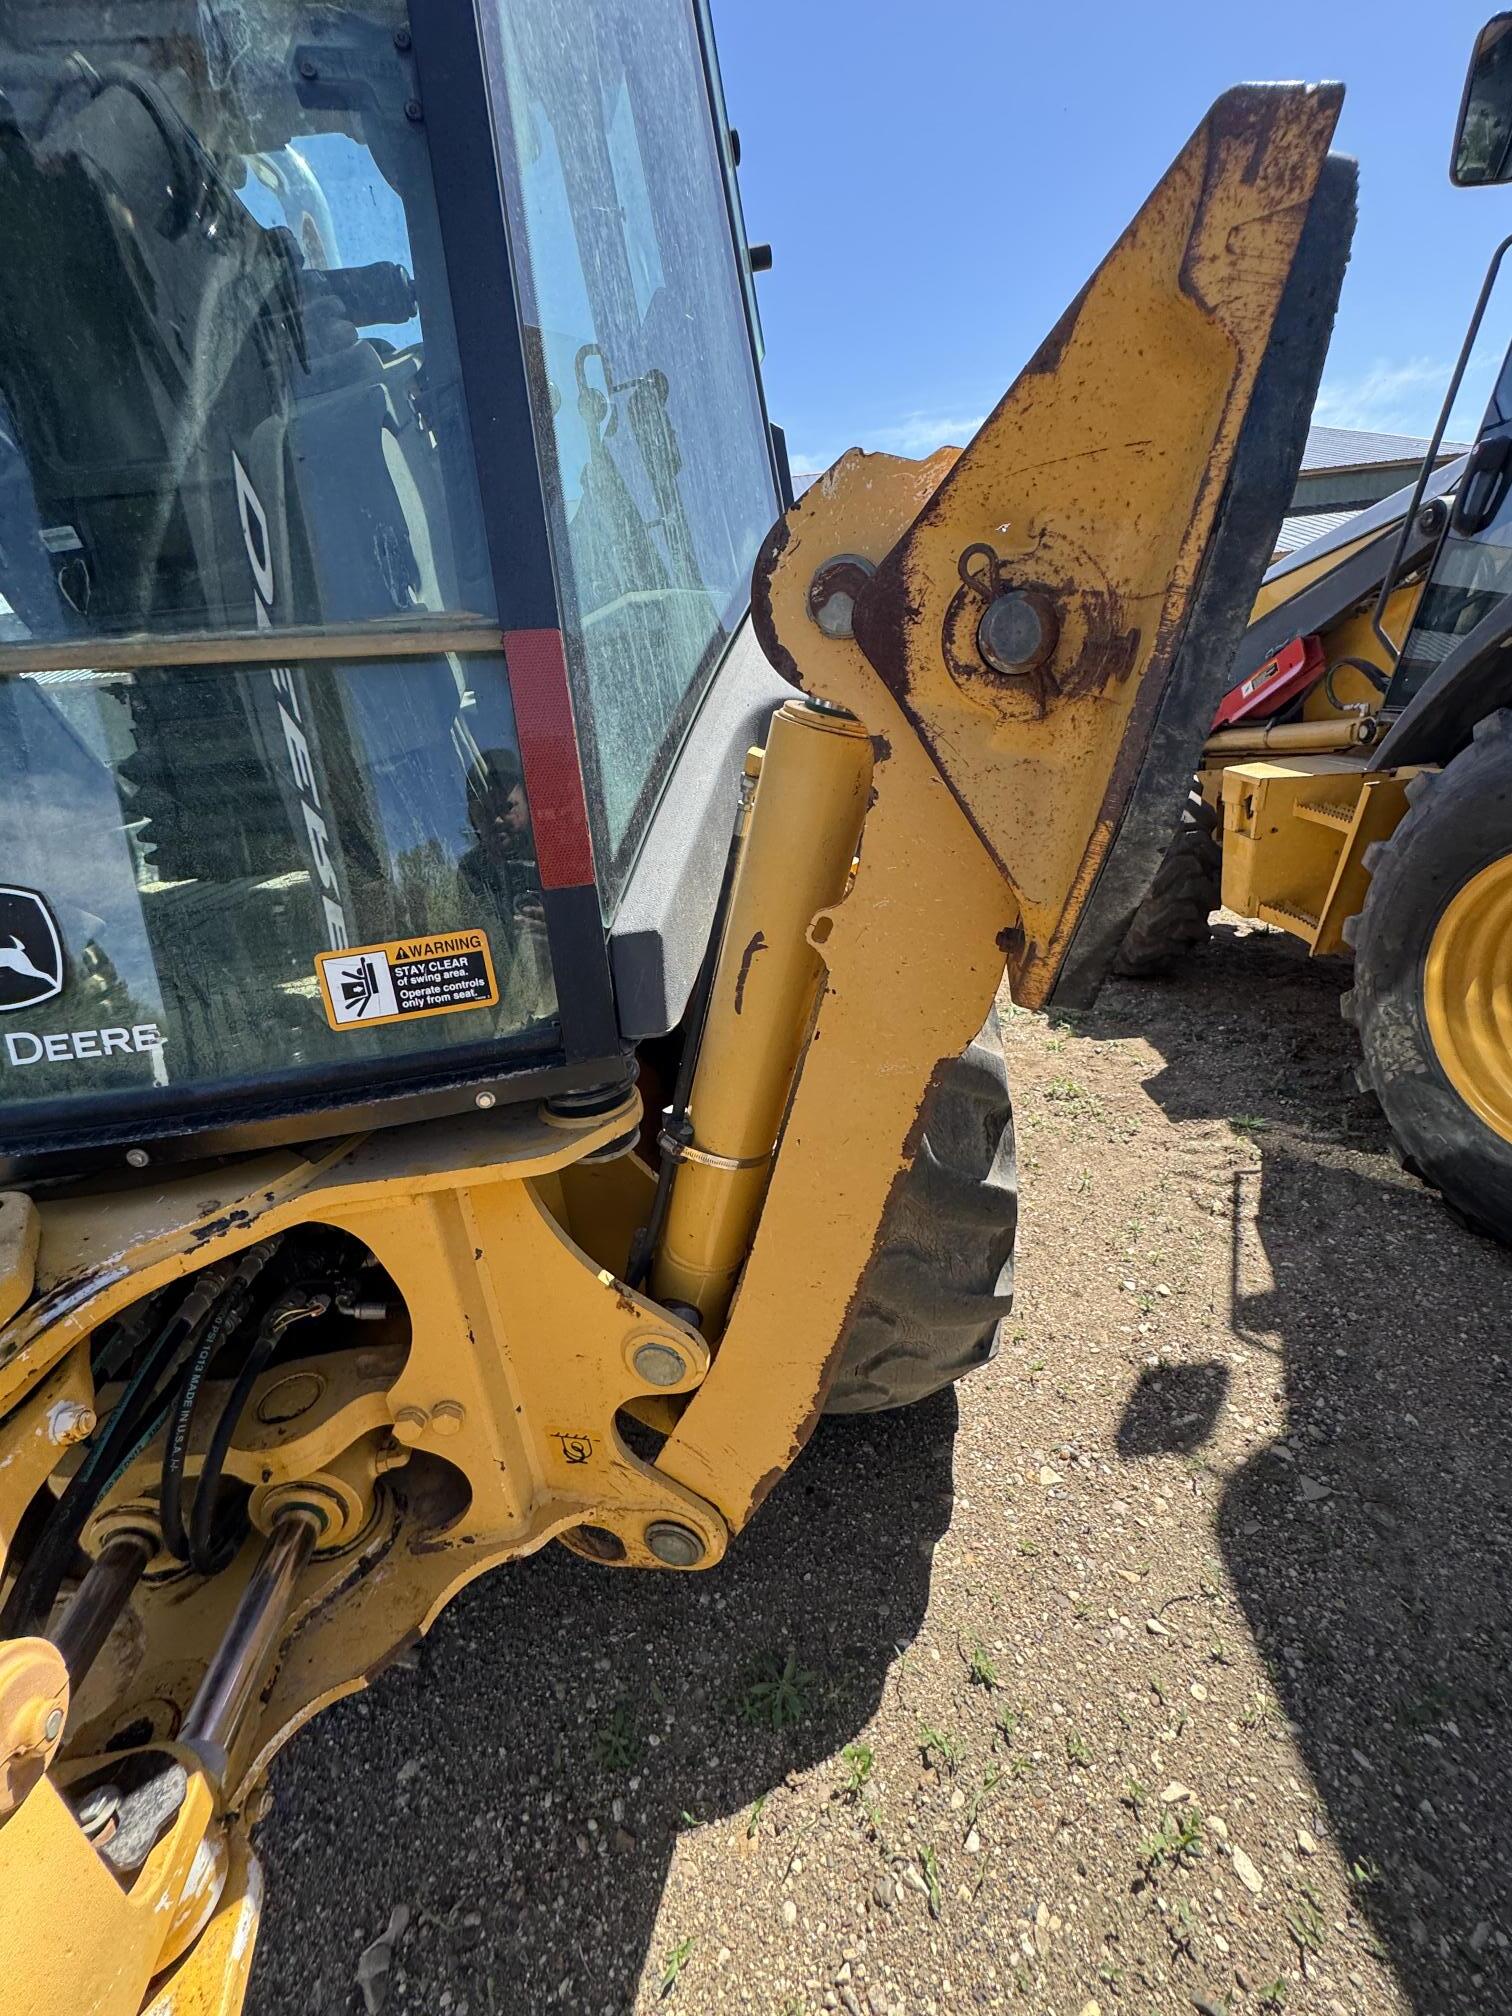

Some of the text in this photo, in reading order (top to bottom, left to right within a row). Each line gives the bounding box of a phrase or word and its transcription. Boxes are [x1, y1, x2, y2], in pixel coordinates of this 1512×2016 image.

[409, 936, 481, 957] WARNING
[395, 957, 468, 977] STAY CLEAR
[397, 968, 468, 987] of swing area.
[400, 978, 485, 1000] Operate controls
[402, 996, 424, 1008] only
[427, 993, 451, 1005] from
[453, 989, 478, 1000] seat.
[4, 1023, 158, 1066] DEERE
[206, 1325, 220, 1343] PSI
[183, 1374, 201, 1407] MADE
[179, 1410, 191, 1422] IN
